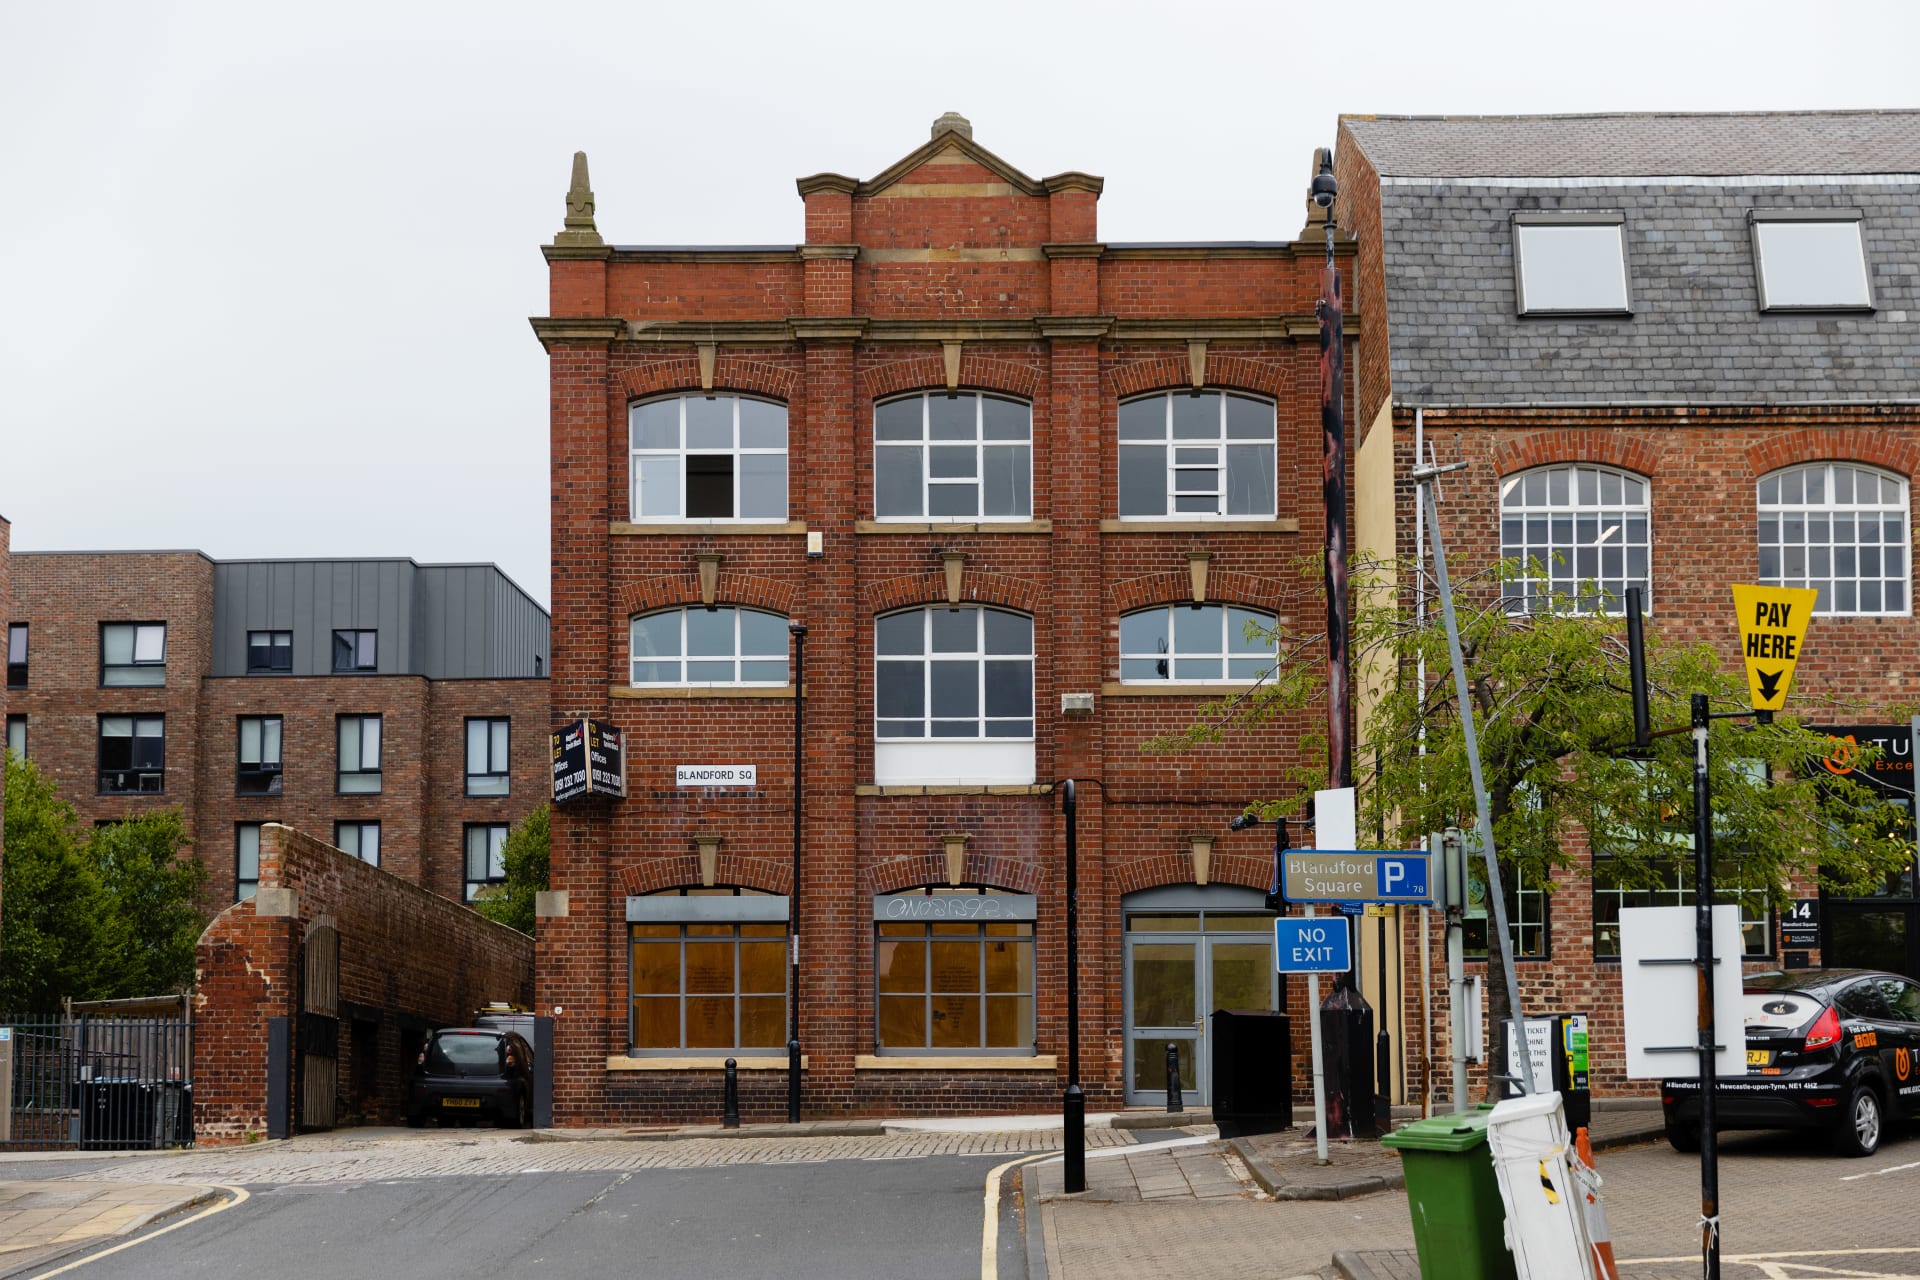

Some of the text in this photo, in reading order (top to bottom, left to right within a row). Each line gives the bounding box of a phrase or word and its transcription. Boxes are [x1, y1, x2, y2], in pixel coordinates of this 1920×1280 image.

[1755, 602, 1791, 627] PAY
[1747, 633, 1796, 659] HERE
[591, 737, 599, 748] LET
[554, 747, 562, 759] LET
[591, 751, 607, 764] Offices
[573, 769, 586, 784] 7030
[678, 770, 734, 780] BLANDFORD
[1290, 860, 1405, 893] Blandford P
[1304, 878, 1363, 895] Square
[1790, 902, 1811, 919] 14
[1298, 928, 1326, 943] NO
[1292, 947, 1333, 962] EXIT
[1850, 1026, 1862, 1034] Find
